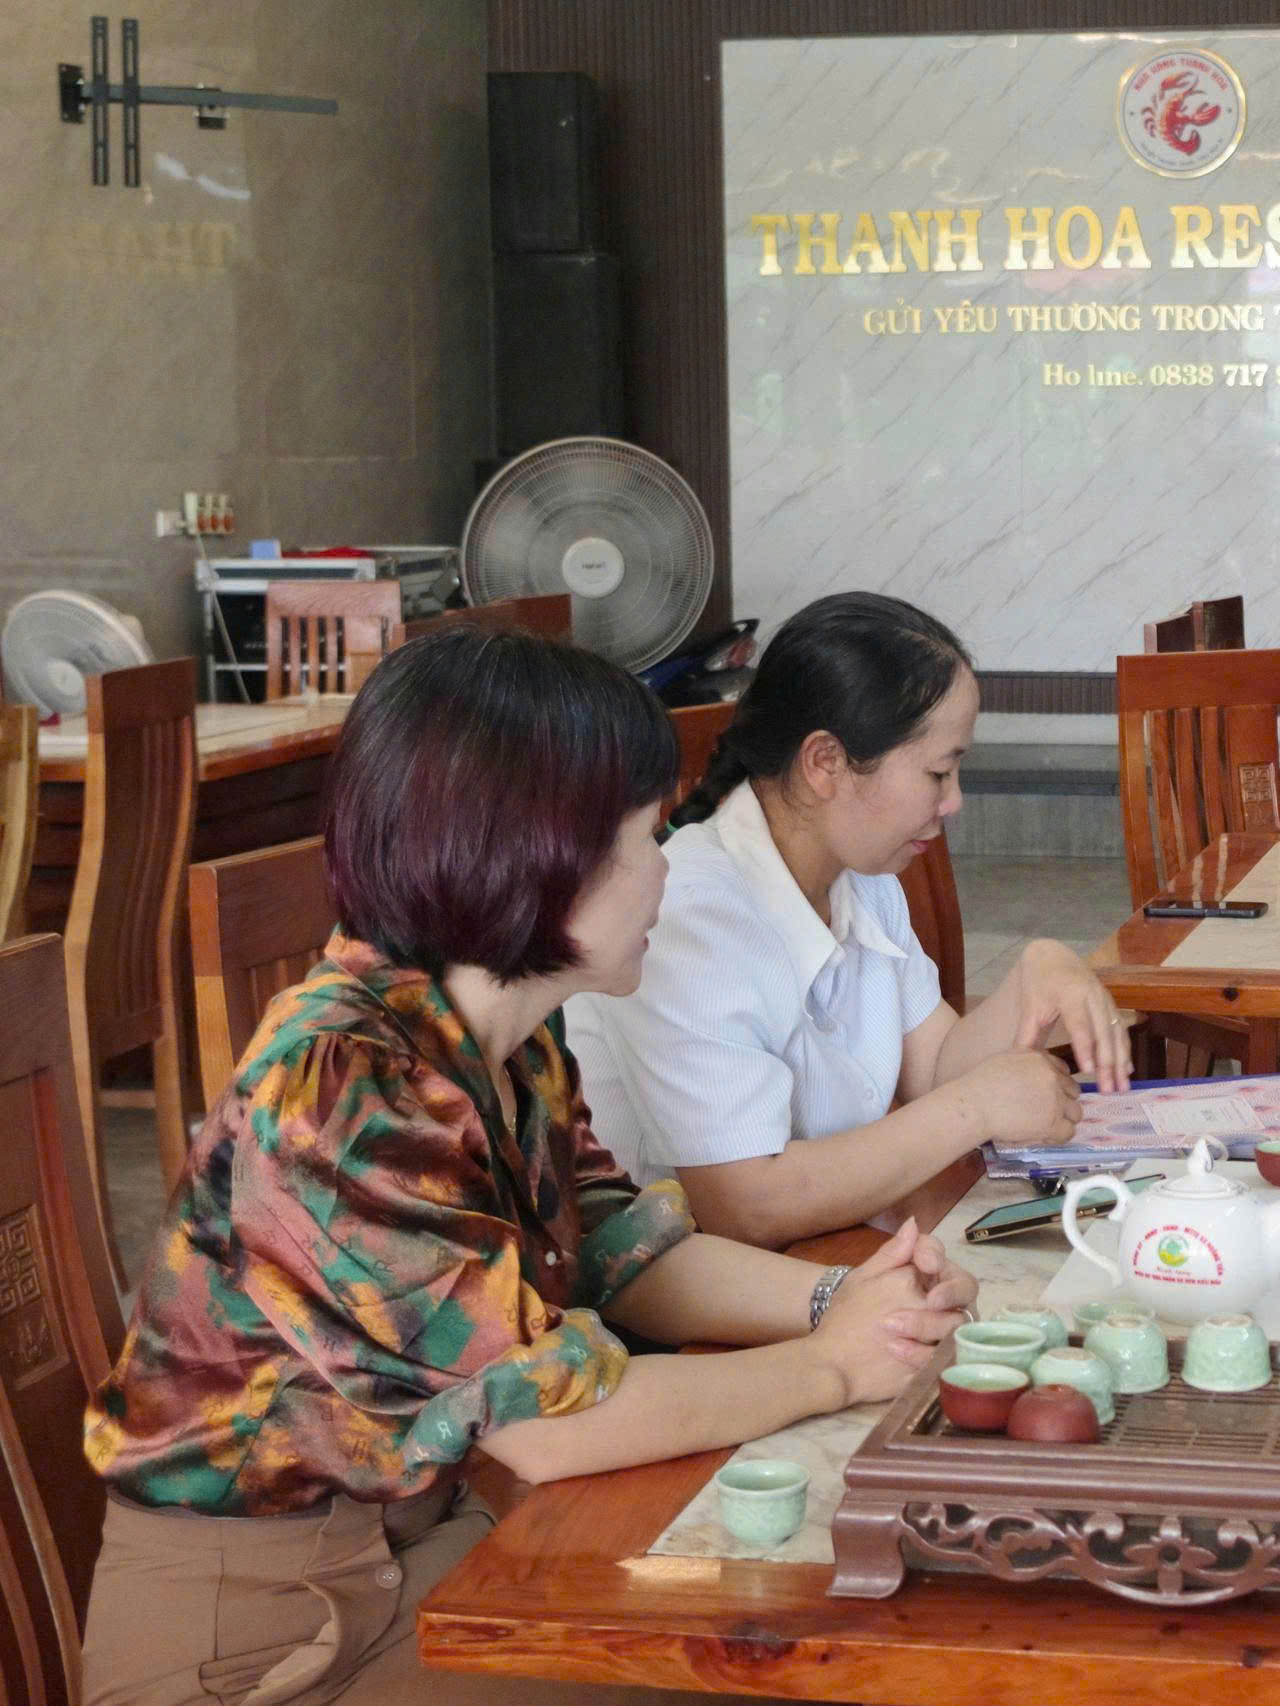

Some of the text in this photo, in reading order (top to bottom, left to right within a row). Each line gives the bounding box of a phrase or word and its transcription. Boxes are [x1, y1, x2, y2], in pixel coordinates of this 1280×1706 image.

[750, 207, 984, 276] THANH
[1003, 205, 1152, 270] HOA
[934, 299, 998, 333] YÊU
[1152, 303, 1266, 332] TRONG
[1150, 364, 1215, 387] 0838
[1222, 364, 1268, 387] 717
